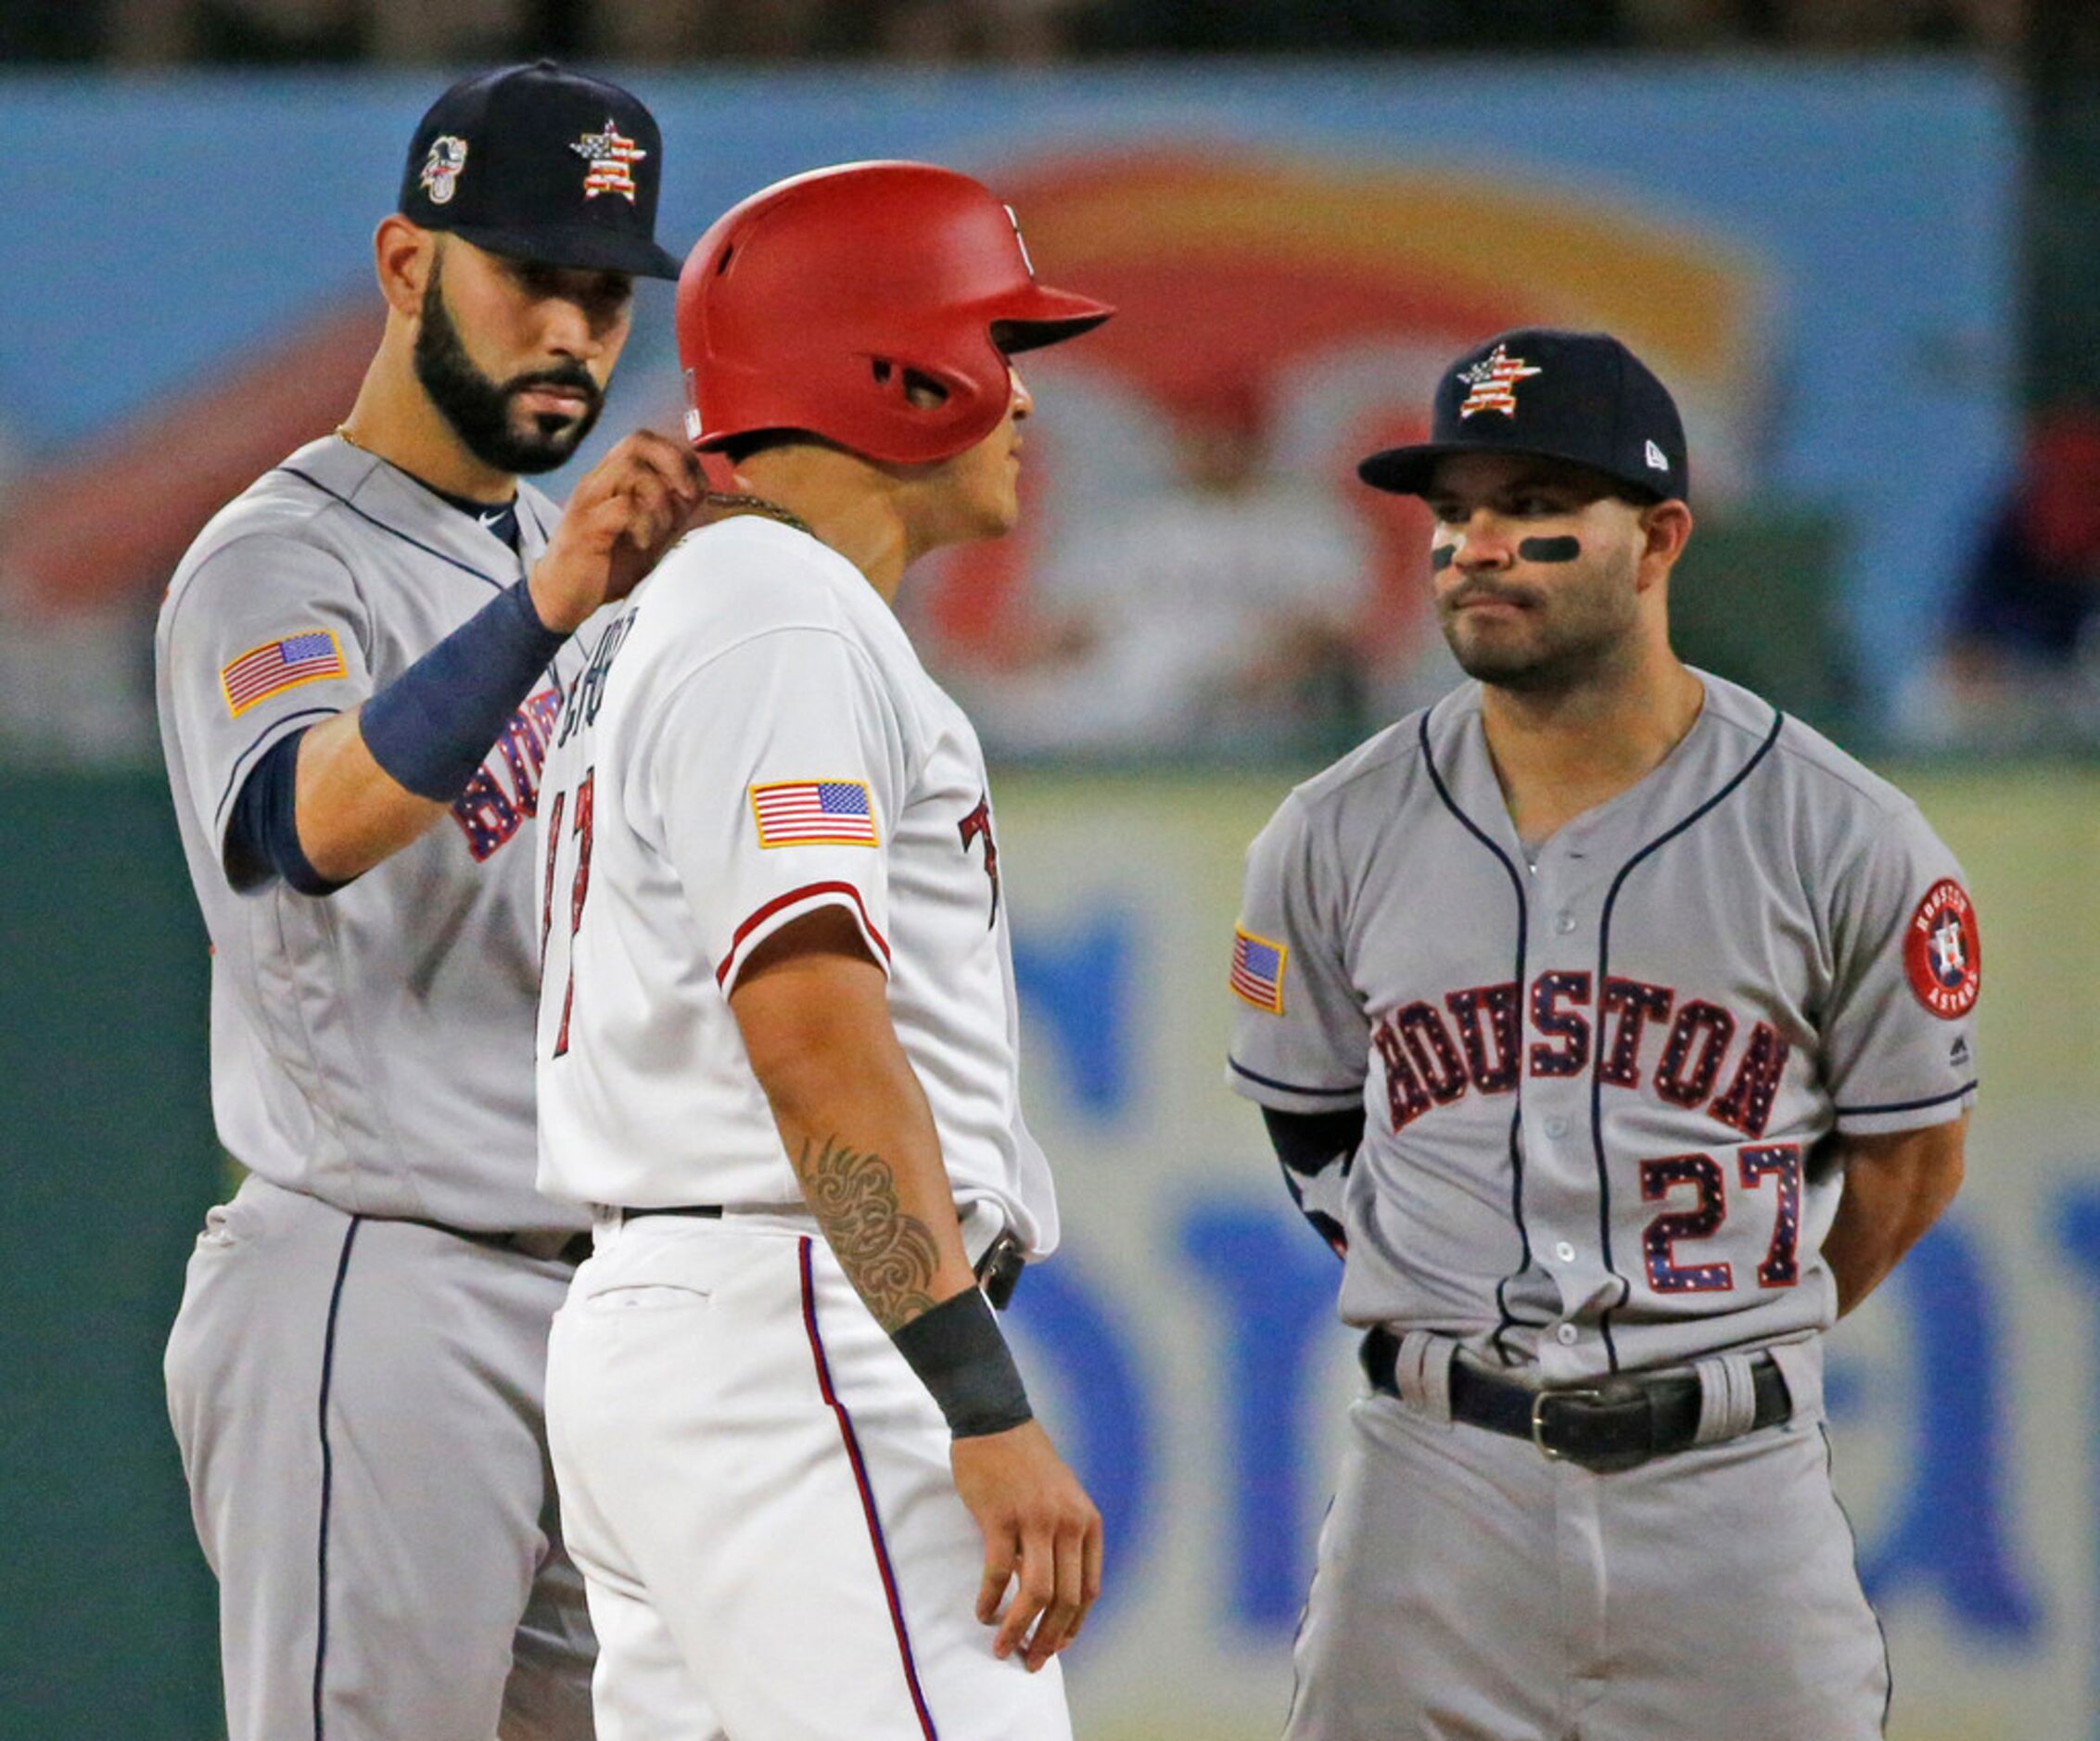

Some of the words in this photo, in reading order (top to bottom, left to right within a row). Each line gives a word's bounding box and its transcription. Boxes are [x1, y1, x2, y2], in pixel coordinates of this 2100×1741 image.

[1916, 885, 1967, 932] HOUSTON
[1928, 971, 1978, 1011] ASTROS
[1373, 970, 1789, 1138] HOUSTON
[1641, 1144, 1801, 1293] 27
